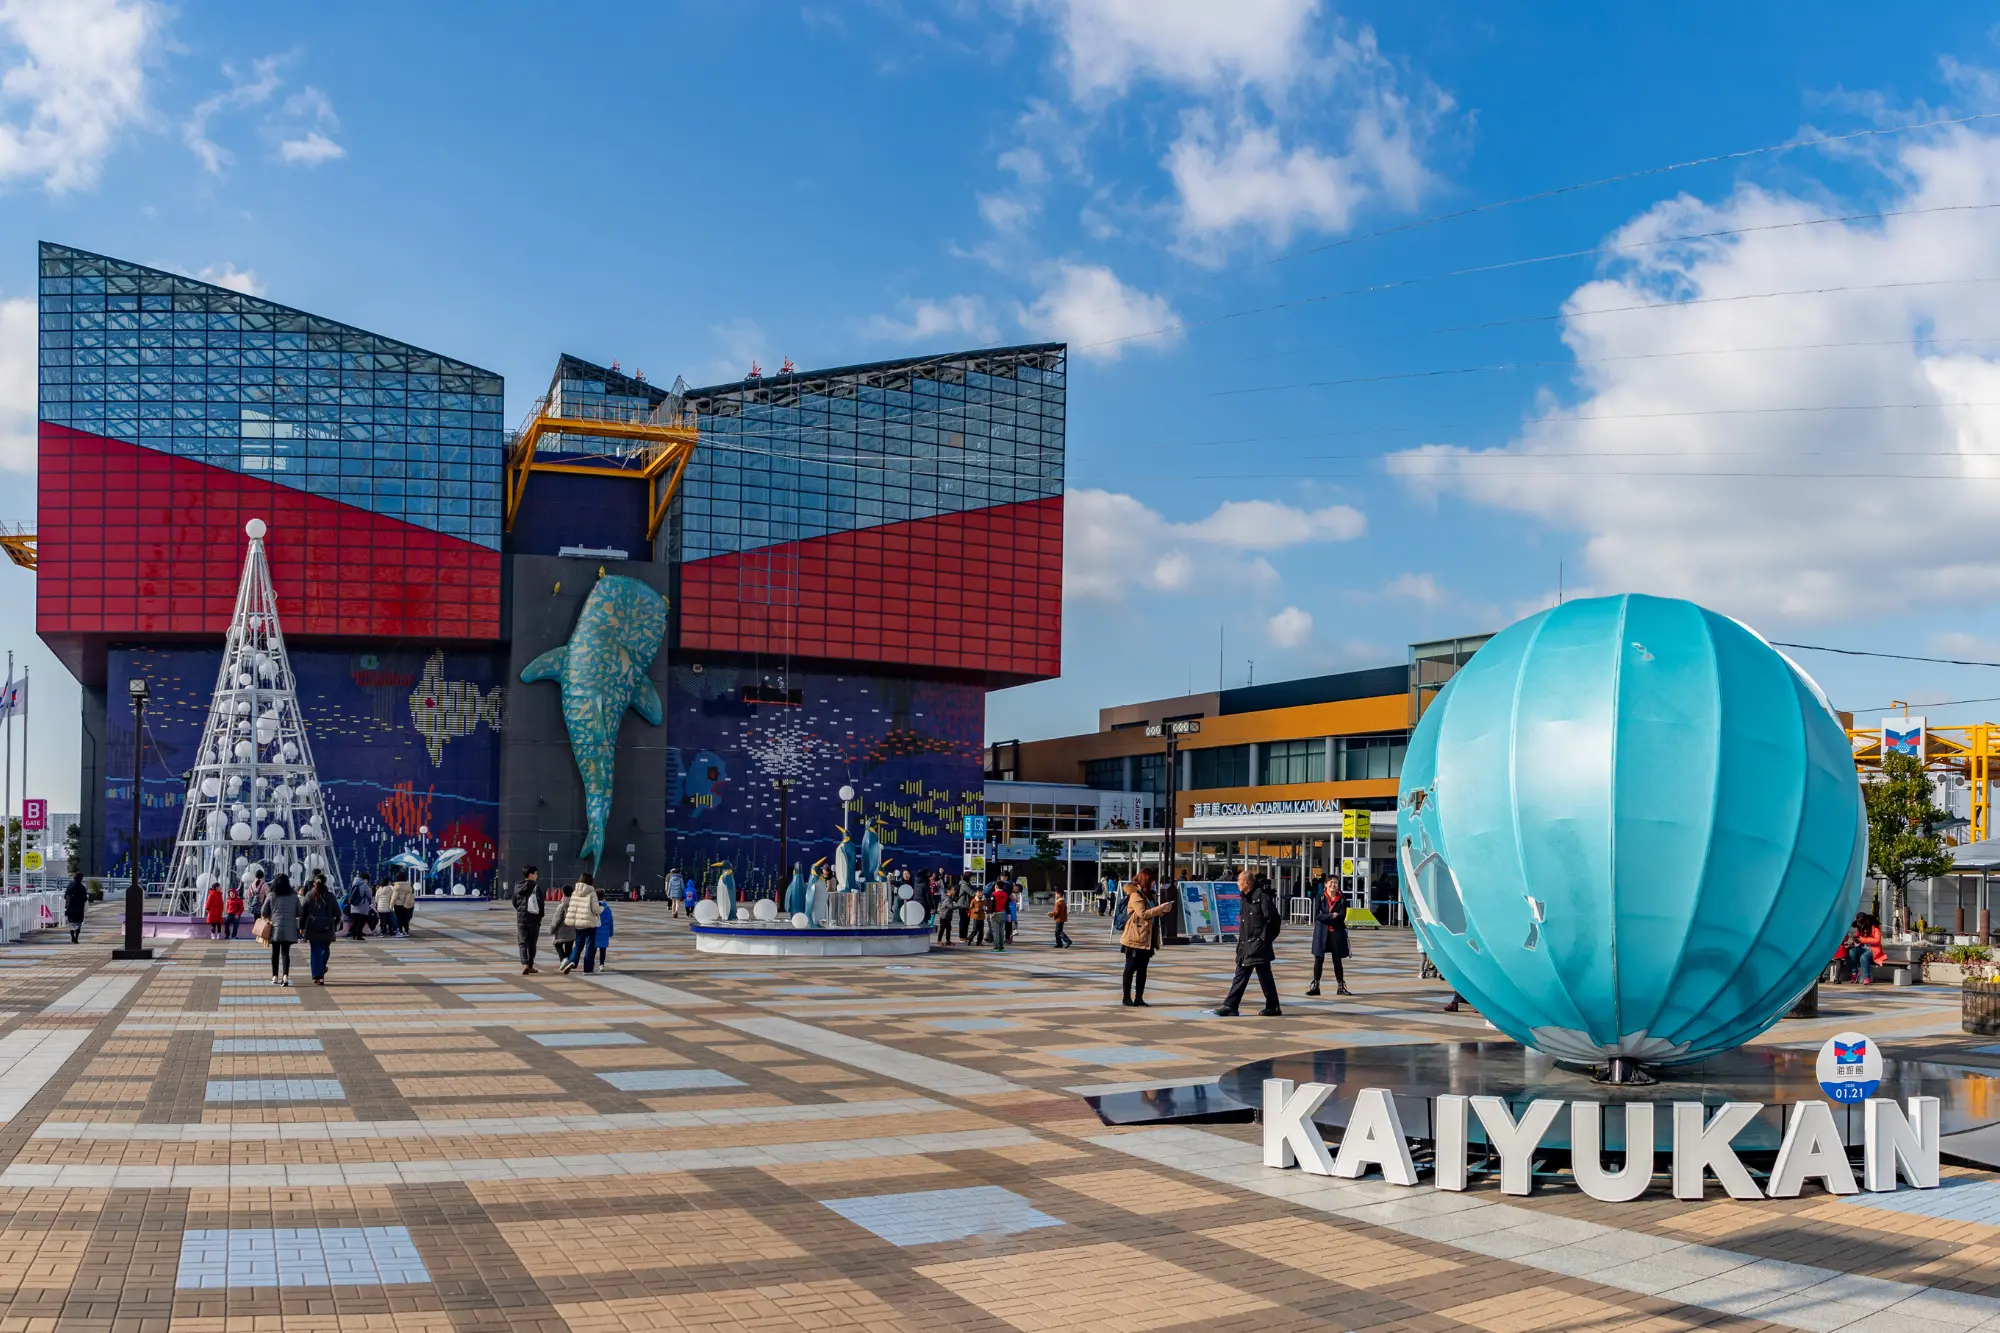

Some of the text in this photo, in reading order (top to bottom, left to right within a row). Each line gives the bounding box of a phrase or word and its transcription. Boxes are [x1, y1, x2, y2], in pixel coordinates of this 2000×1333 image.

[28, 803, 40, 818] B
[1221, 804, 1248, 816] OSAKA
[1250, 801, 1293, 815] AQUARIUM
[1294, 799, 1341, 813] KAIYUKAN
[1835, 1088, 1863, 1099] 01.21
[1262, 1078, 1940, 1202] KAIYUKAN
